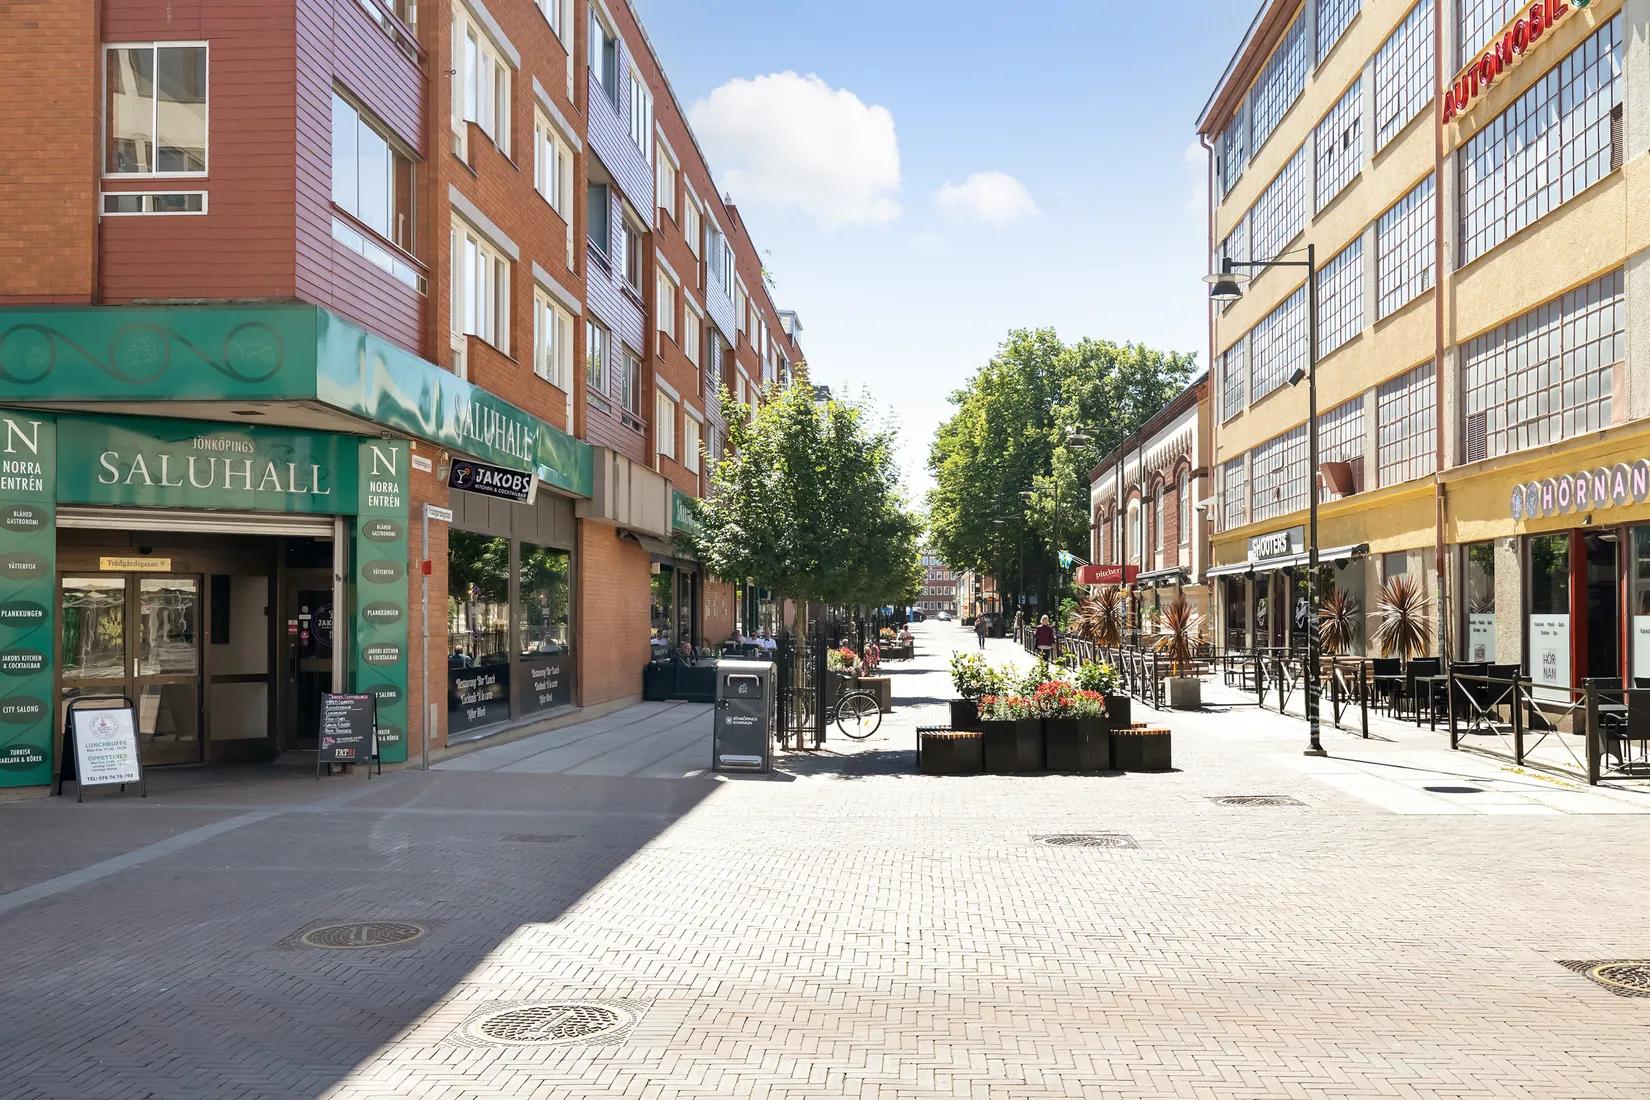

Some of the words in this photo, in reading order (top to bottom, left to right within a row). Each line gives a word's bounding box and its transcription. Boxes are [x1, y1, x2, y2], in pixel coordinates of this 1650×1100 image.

[454, 393, 532, 462] SALUHALL
[3, 419, 42, 454] N
[192, 436, 254, 453] JÖNKÖPINGS
[3, 460, 42, 474] NORRA
[370, 446, 398, 476] N
[98, 452, 330, 494] SALUHALL
[476, 468, 530, 493] JAKOBS
[1, 475, 42, 491] ENTRÉN
[370, 482, 399, 493] NORRA
[1543, 467, 1646, 509] HÖRNAN
[368, 494, 400, 508] ENTRÉN
[498, 488, 526, 498] COCKTAILBAR
[1252, 532, 1288, 557] SHOOTERS
[107, 560, 158, 568] Trädgårdsgatan
[1543, 652, 1555, 665] HÖR
[1544, 668, 1556, 679] NAN
